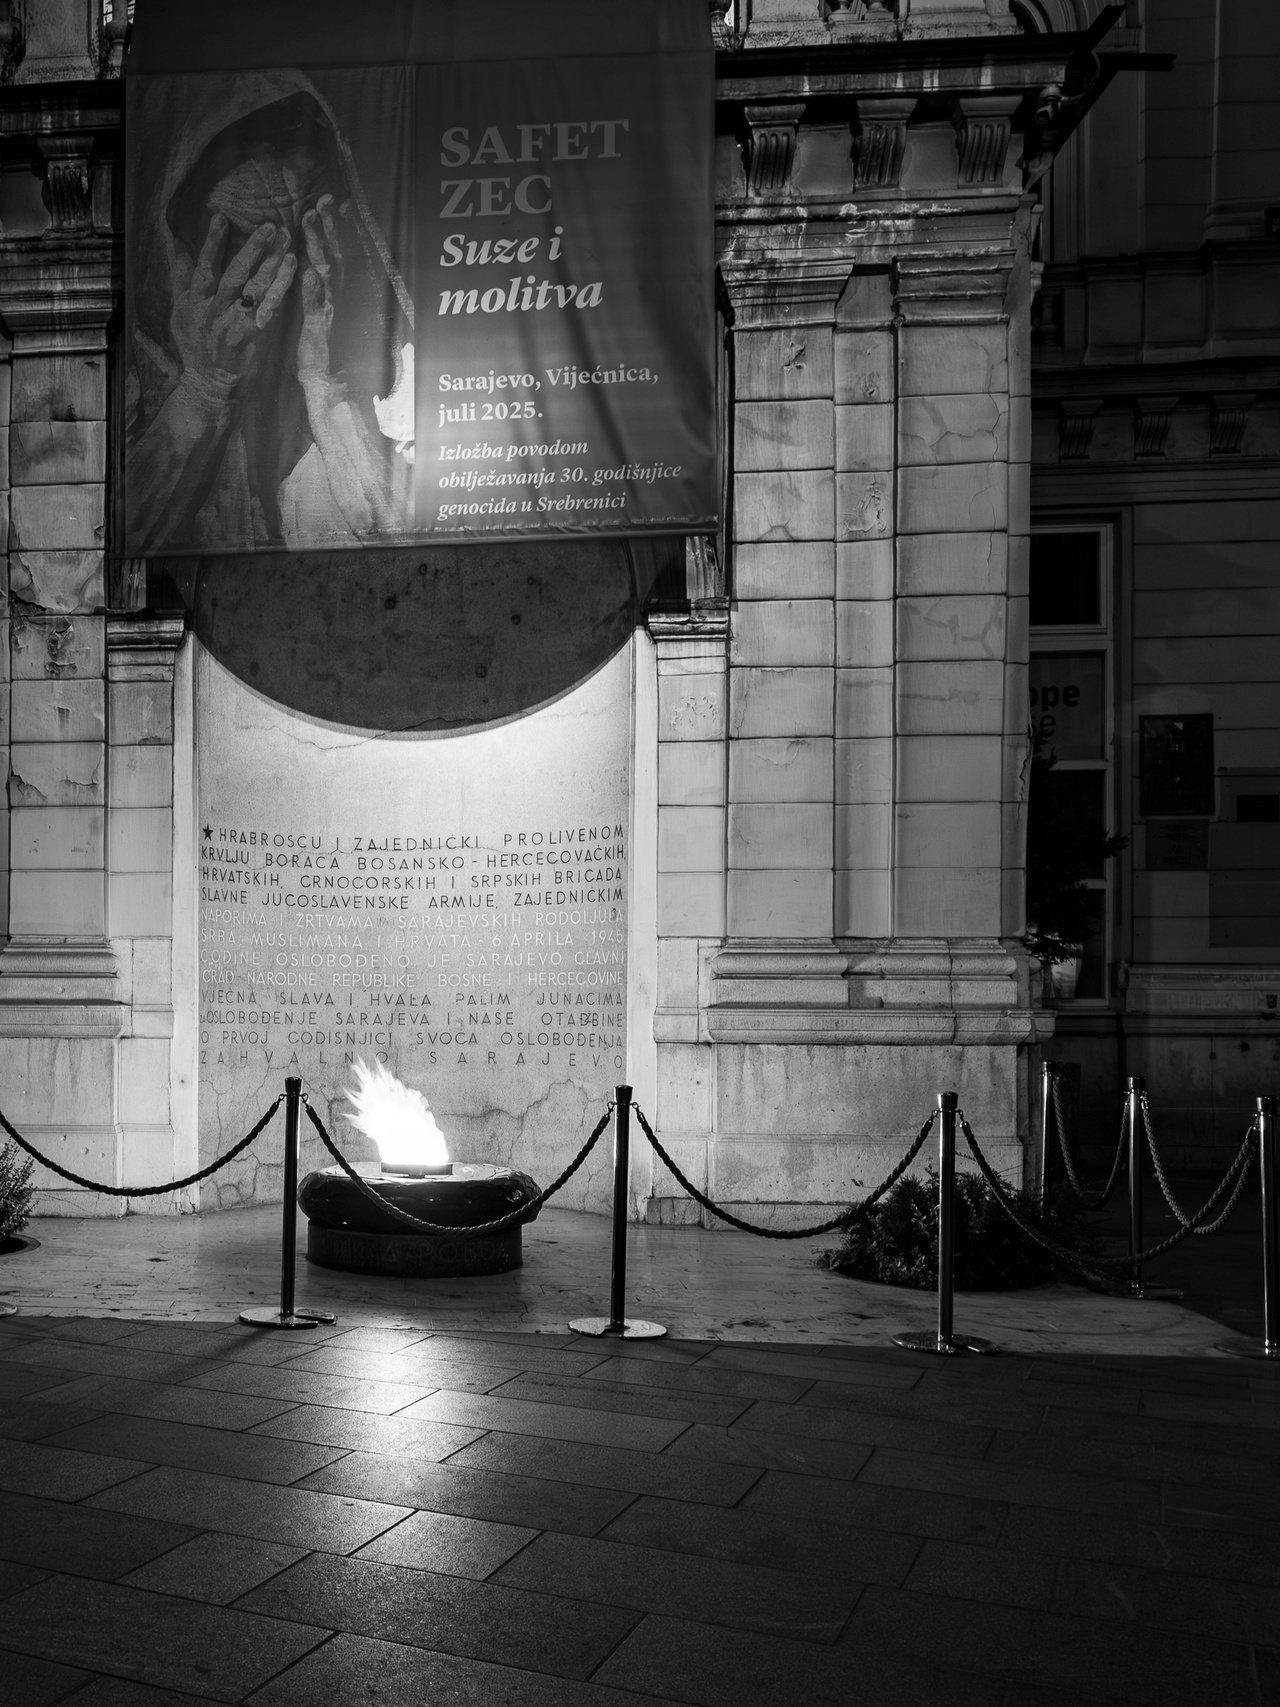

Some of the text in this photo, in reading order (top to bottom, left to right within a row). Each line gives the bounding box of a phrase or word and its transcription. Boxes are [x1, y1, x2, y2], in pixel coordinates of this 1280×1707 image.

[441, 120, 629, 167] SAFET
[439, 175, 552, 218] ZEC
[440, 226, 563, 266] Suze i
[438, 275, 603, 315] molitva
[439, 364, 659, 394] Sarajevo, Vijećnica,
[438, 402, 543, 427] juli 2025.
[438, 440, 588, 461] Izložba povodom
[438, 463, 681, 492] obilježavanja 30. godišnjice
[437, 492, 626, 521] genocida u Srebrenici
[504, 824, 624, 846] PROLIVENOM
[201, 846, 249, 865] KRVLJU
[265, 853, 340, 869] BORACA
[358, 856, 465, 870] BOSANSKO
[451, 876, 454, 889] I
[471, 873, 541, 888] SRPSKIH
[201, 887, 248, 904] SLAVNE
[201, 909, 267, 926] NAPORIMA
[280, 913, 283, 926] I
[398, 913, 521, 929] SARAJEVSKIH
[251, 932, 363, 948] MUSLIMANA
[377, 936, 380, 948] I
[395, 935, 471, 948] HRVATA
[510, 932, 574, 947] APRILA
[428, 954, 450, 968] JE
[466, 952, 562, 967] SARAJEVO
[247, 972, 317, 986] NARODNE
[333, 974, 415, 987] REPUBLIKE
[438, 973, 491, 987] BOSNE
[508, 973, 511, 986] I
[279, 991, 335, 1005] SLAVA
[349, 993, 352, 1006] I
[455, 993, 511, 1006] PALIM
[537, 992, 623, 1006] JUNACIMA
[335, 1012, 430, 1026] SARAJEVA
[447, 1012, 450, 1025] I
[201, 1031, 209, 1044] O
[222, 1030, 268, 1044] PRVOJ
